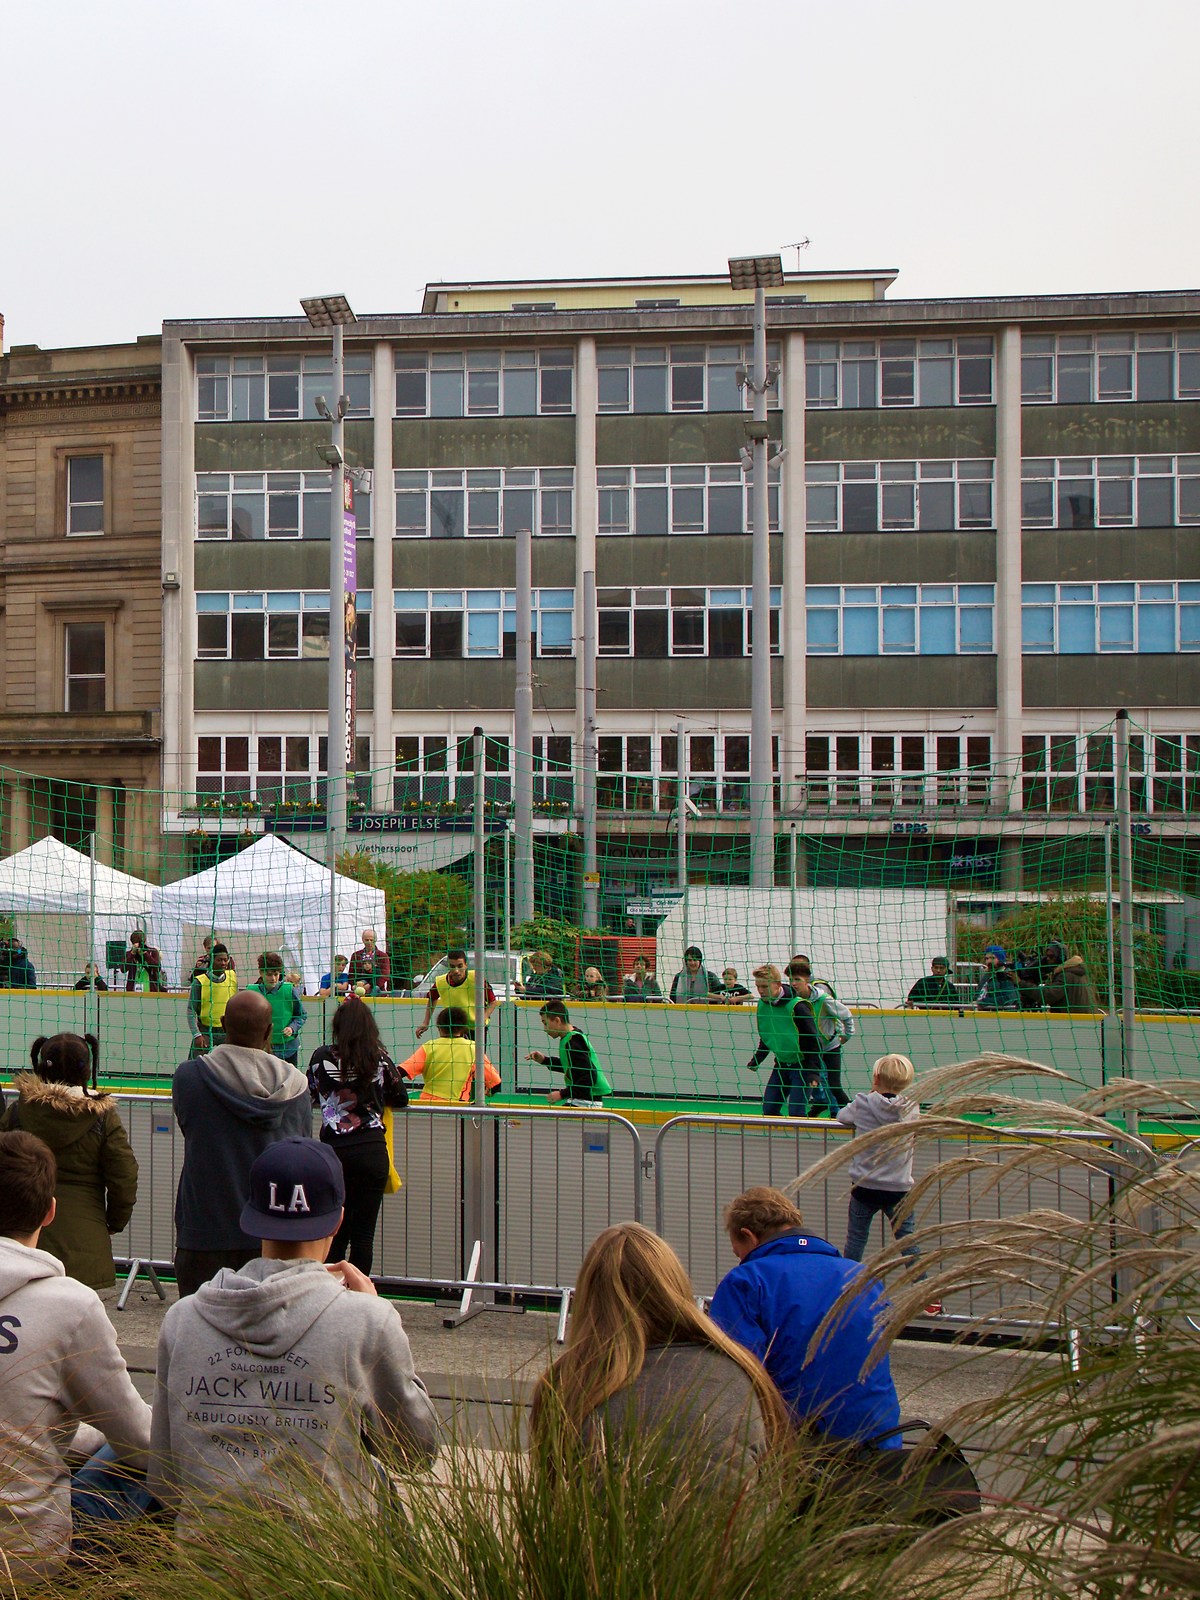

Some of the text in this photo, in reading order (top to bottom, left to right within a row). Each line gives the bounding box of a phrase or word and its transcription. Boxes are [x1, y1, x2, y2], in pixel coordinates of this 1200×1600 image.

[358, 818, 406, 831] JOSEPH
[411, 818, 441, 829] ELSE
[905, 823, 928, 833] RBS
[356, 844, 419, 854] Wetherspoon
[268, 1182, 310, 1212] LA
[207, 1352, 223, 1366] 22
[230, 1362, 286, 1375] SALCOMBE
[185, 1376, 336, 1405] JACK WILLS
[187, 1411, 329, 1430] FABULOUSLY BRITISH
[211, 1434, 246, 1457] GREAT
